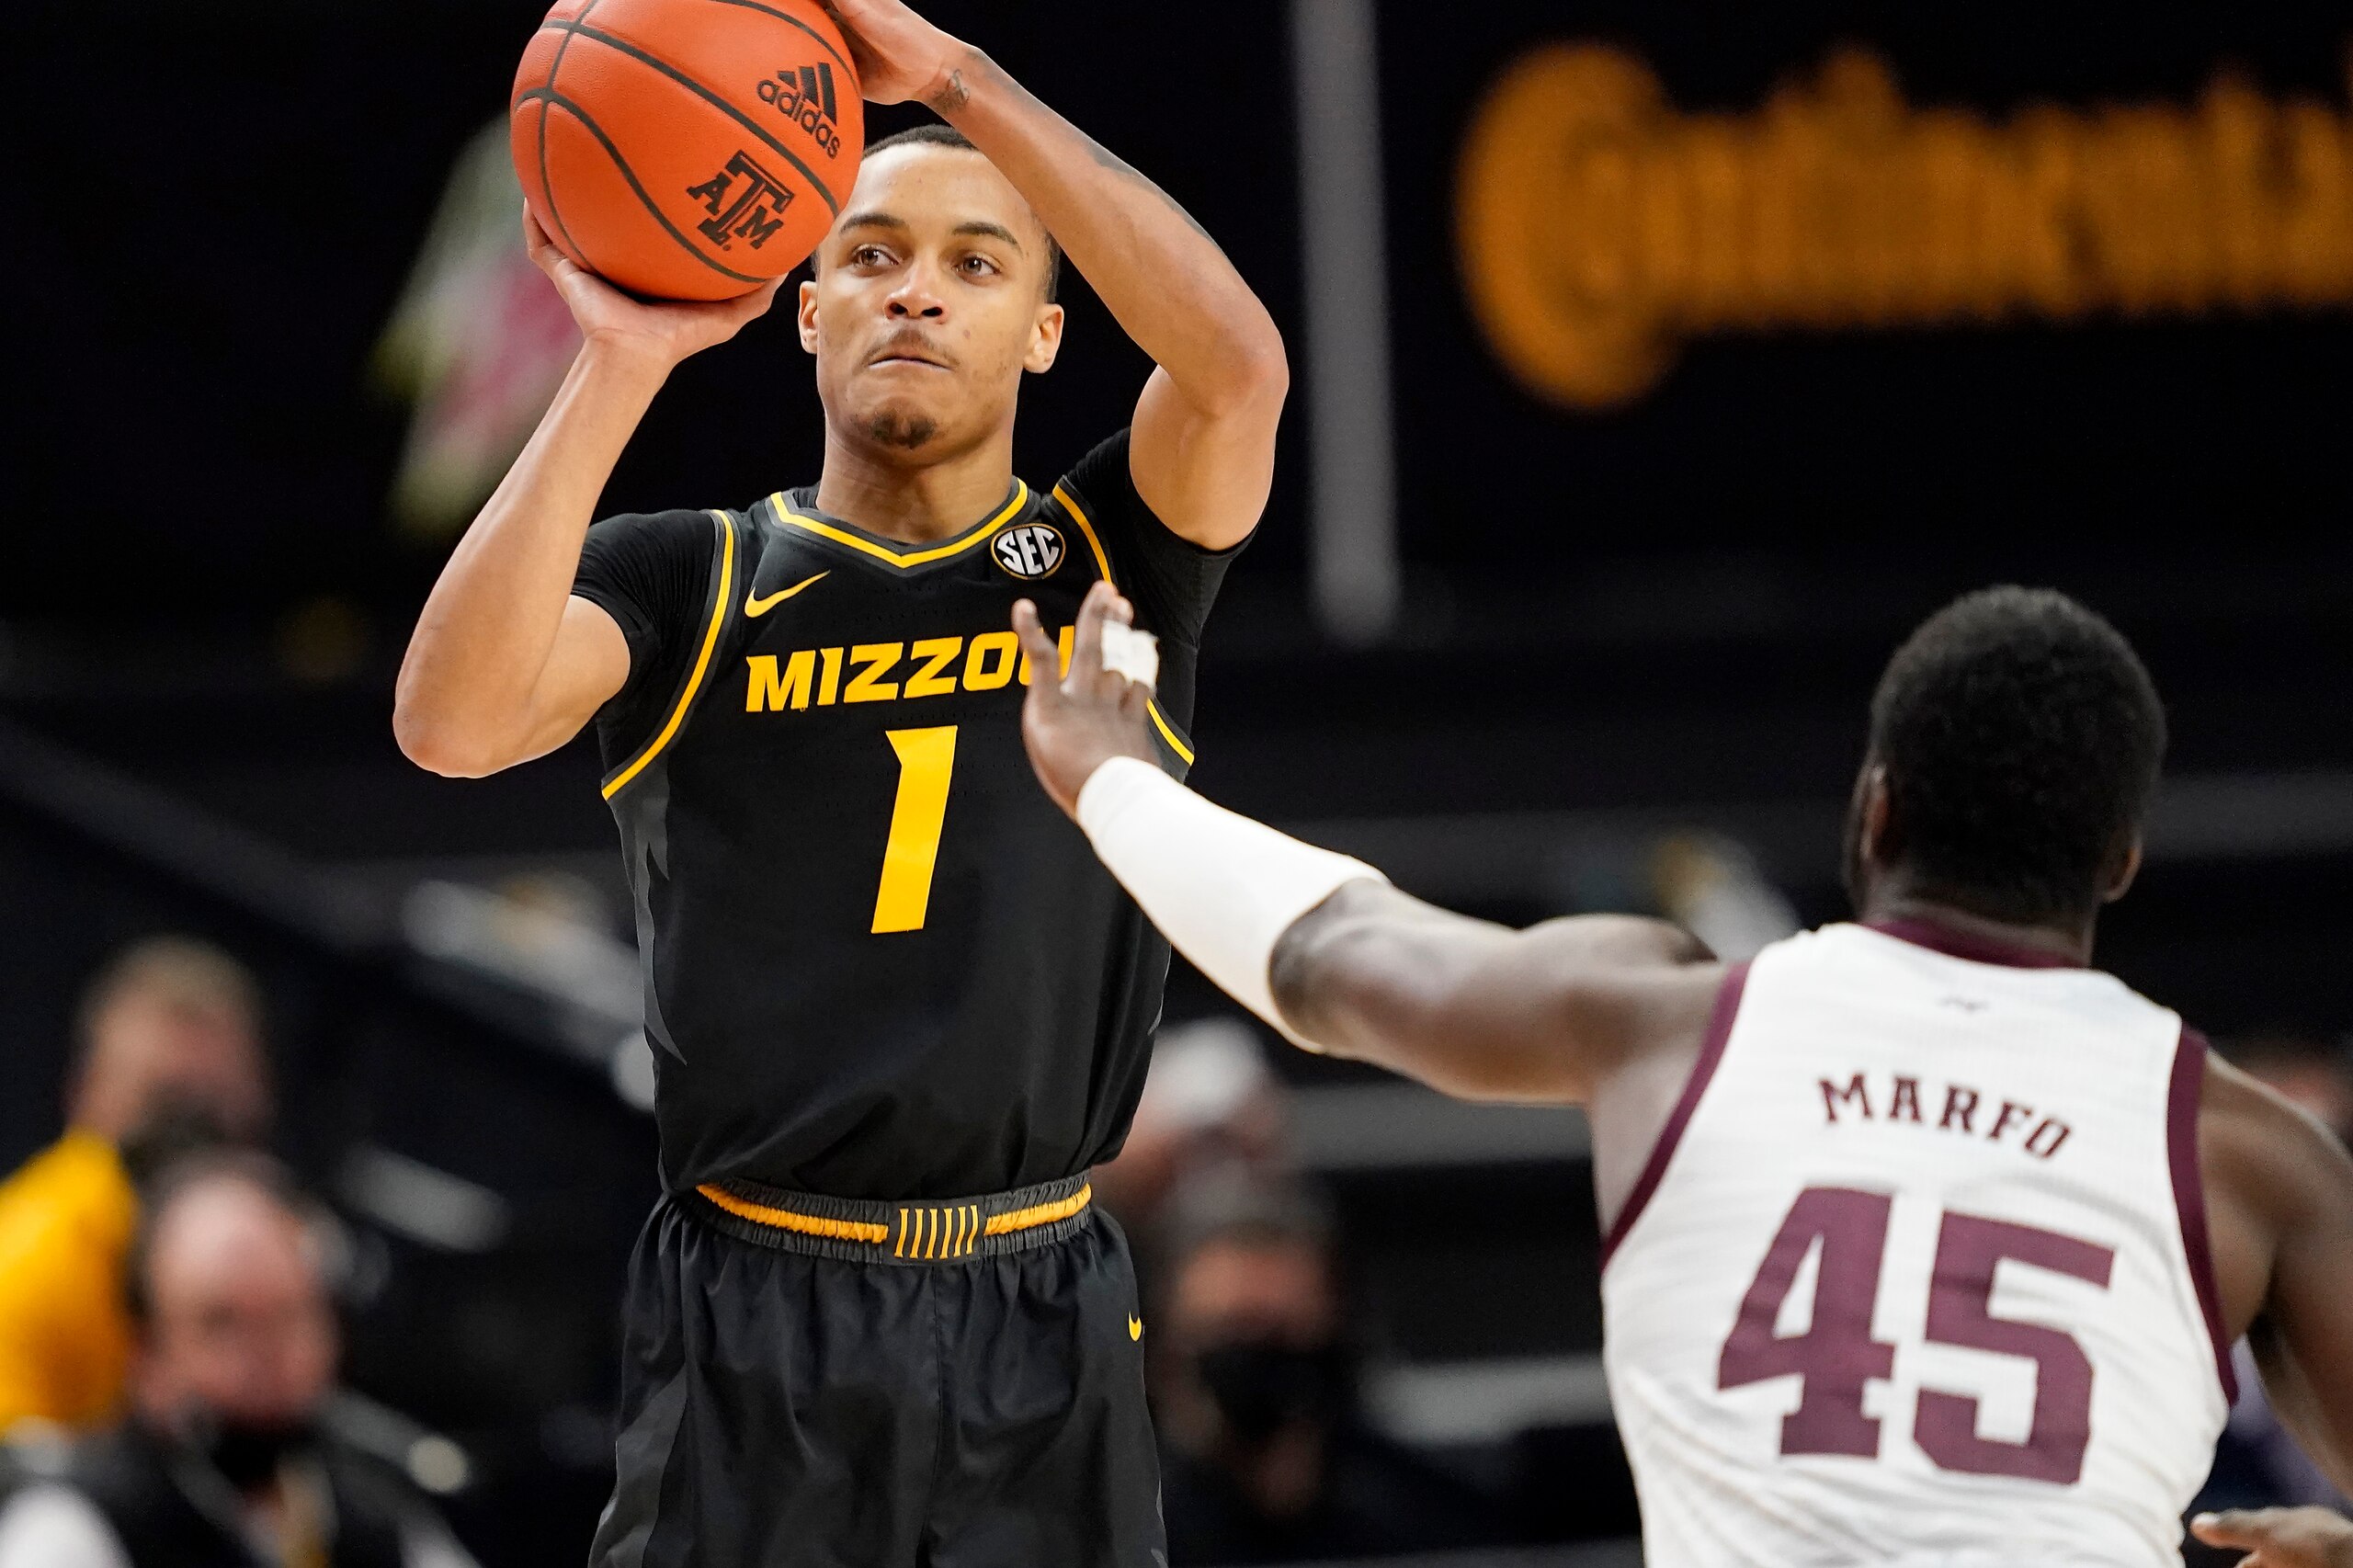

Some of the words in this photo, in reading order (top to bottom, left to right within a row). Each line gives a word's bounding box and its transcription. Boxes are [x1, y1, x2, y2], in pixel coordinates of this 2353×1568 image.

[756, 79, 841, 160] adidas
[996, 527, 1060, 575] SEC
[871, 725, 958, 934] 1
[1817, 1073, 2073, 1160] MARFO
[1718, 1186, 2115, 1486] 45
